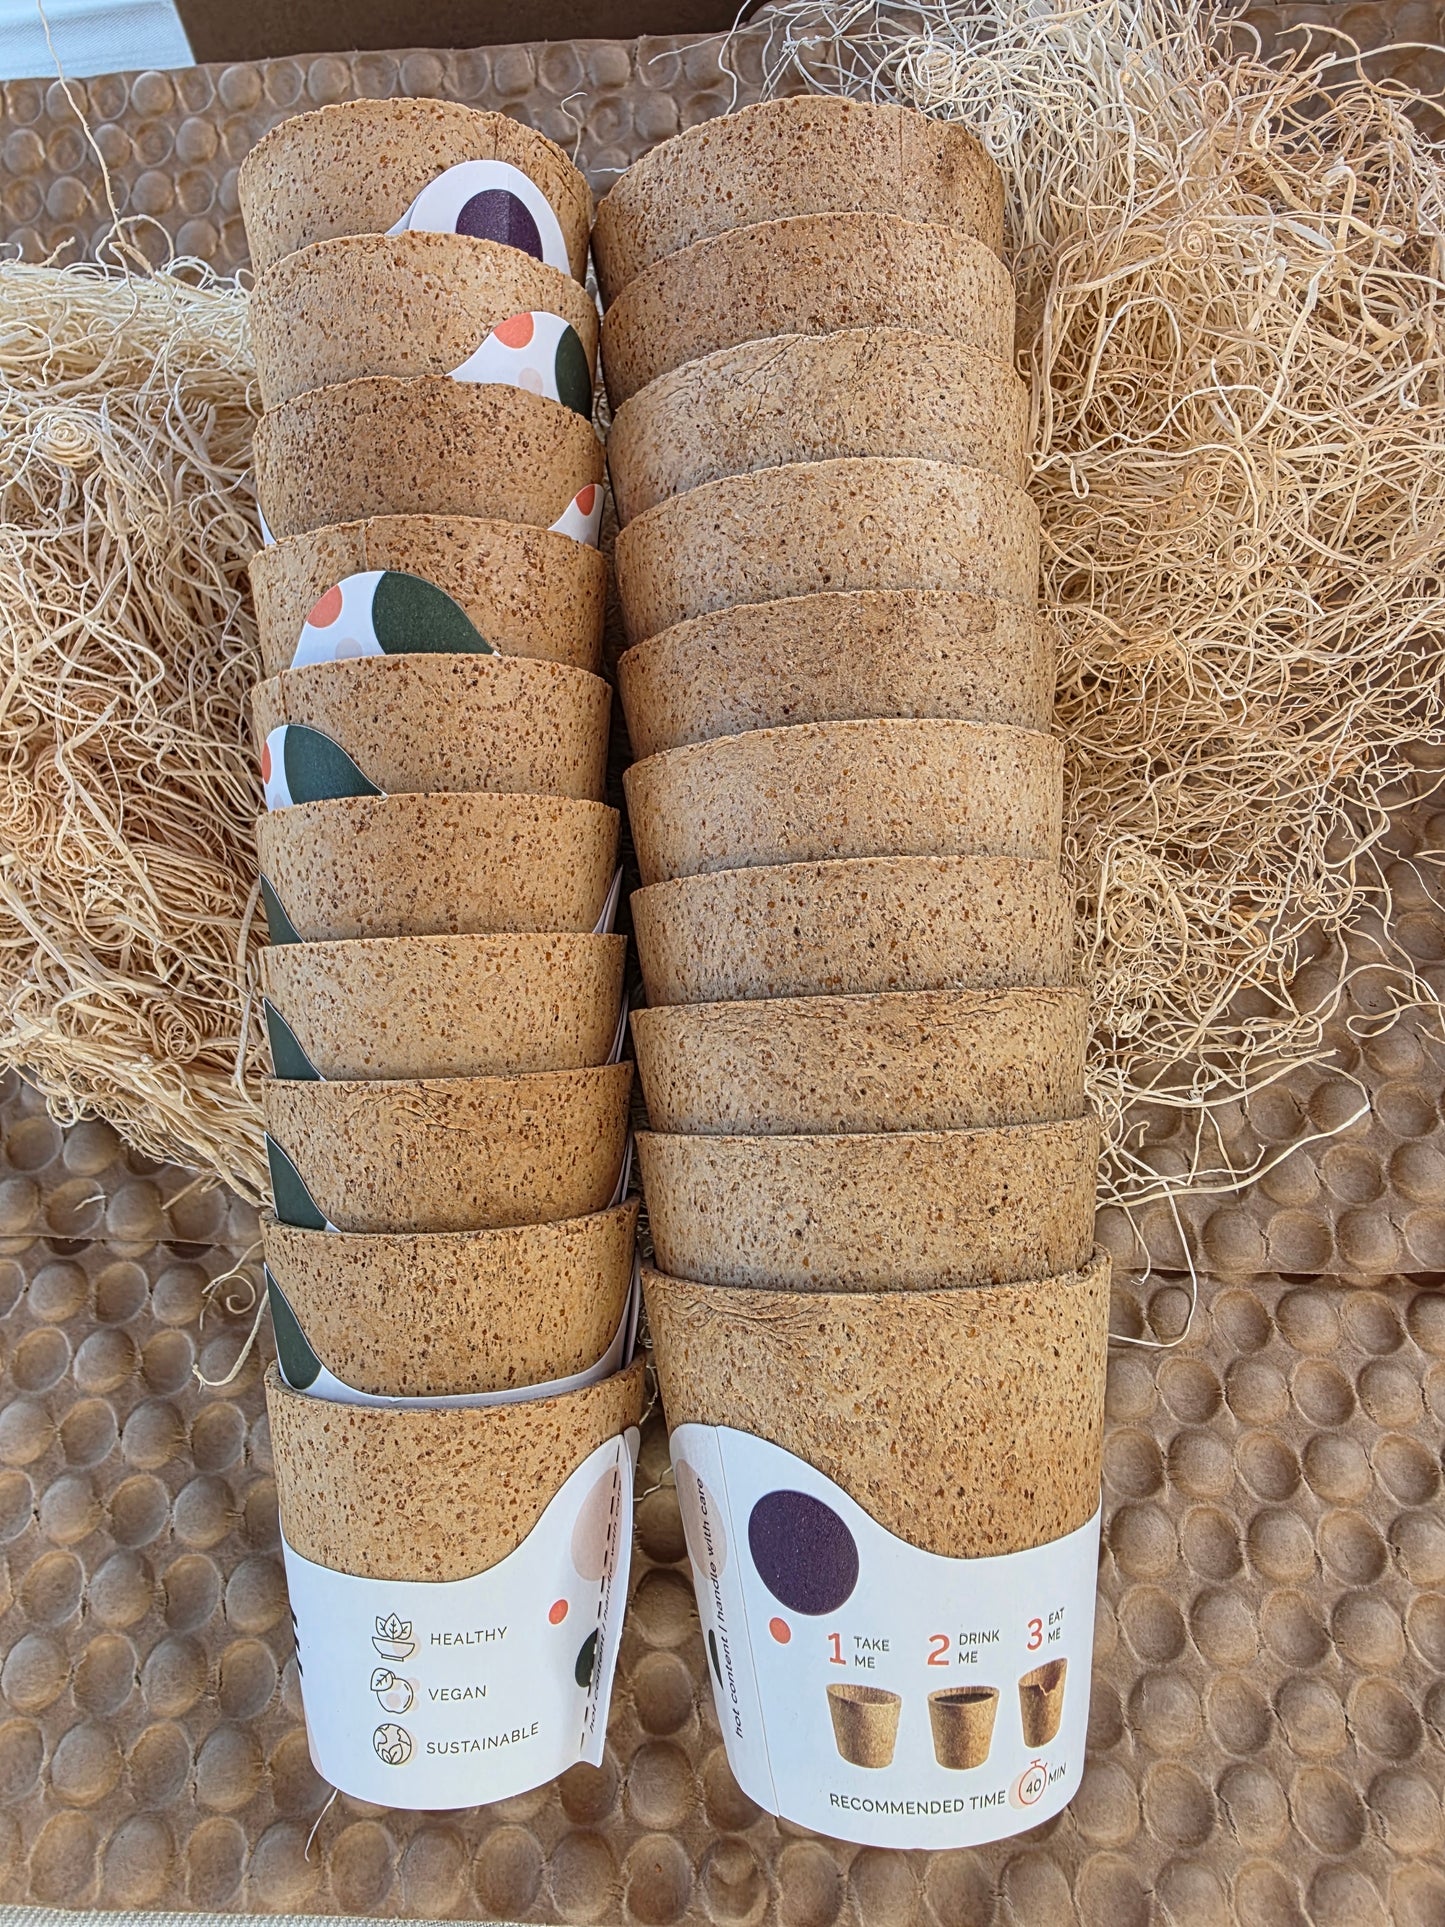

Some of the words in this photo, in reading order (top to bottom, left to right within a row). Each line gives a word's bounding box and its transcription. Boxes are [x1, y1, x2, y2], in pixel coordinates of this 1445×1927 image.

[696, 1478, 708, 1516] care
[702, 1521, 714, 1556] with
[709, 1562, 726, 1622] handle
[430, 1626, 507, 1645] HEALTHY
[1026, 1617, 1043, 1651] 3
[1048, 1607, 1065, 1625] EAT
[1048, 1627, 1061, 1643] ME
[827, 1632, 847, 1665] 1
[853, 1636, 890, 1652] TAKE
[854, 1655, 876, 1669] ME
[927, 1633, 950, 1666] 2
[958, 1629, 1000, 1645] DRINK
[958, 1651, 978, 1664] ME
[721, 1636, 738, 1705] content
[428, 1685, 487, 1701] VEGAN
[426, 1721, 539, 1754] SUSTAINABLE
[732, 1707, 744, 1739] hot
[829, 1793, 965, 1814] RECOMMENDED
[969, 1790, 1006, 1810] TIME
[1026, 1778, 1042, 1794] 40
[1048, 1762, 1067, 1786] MIN
